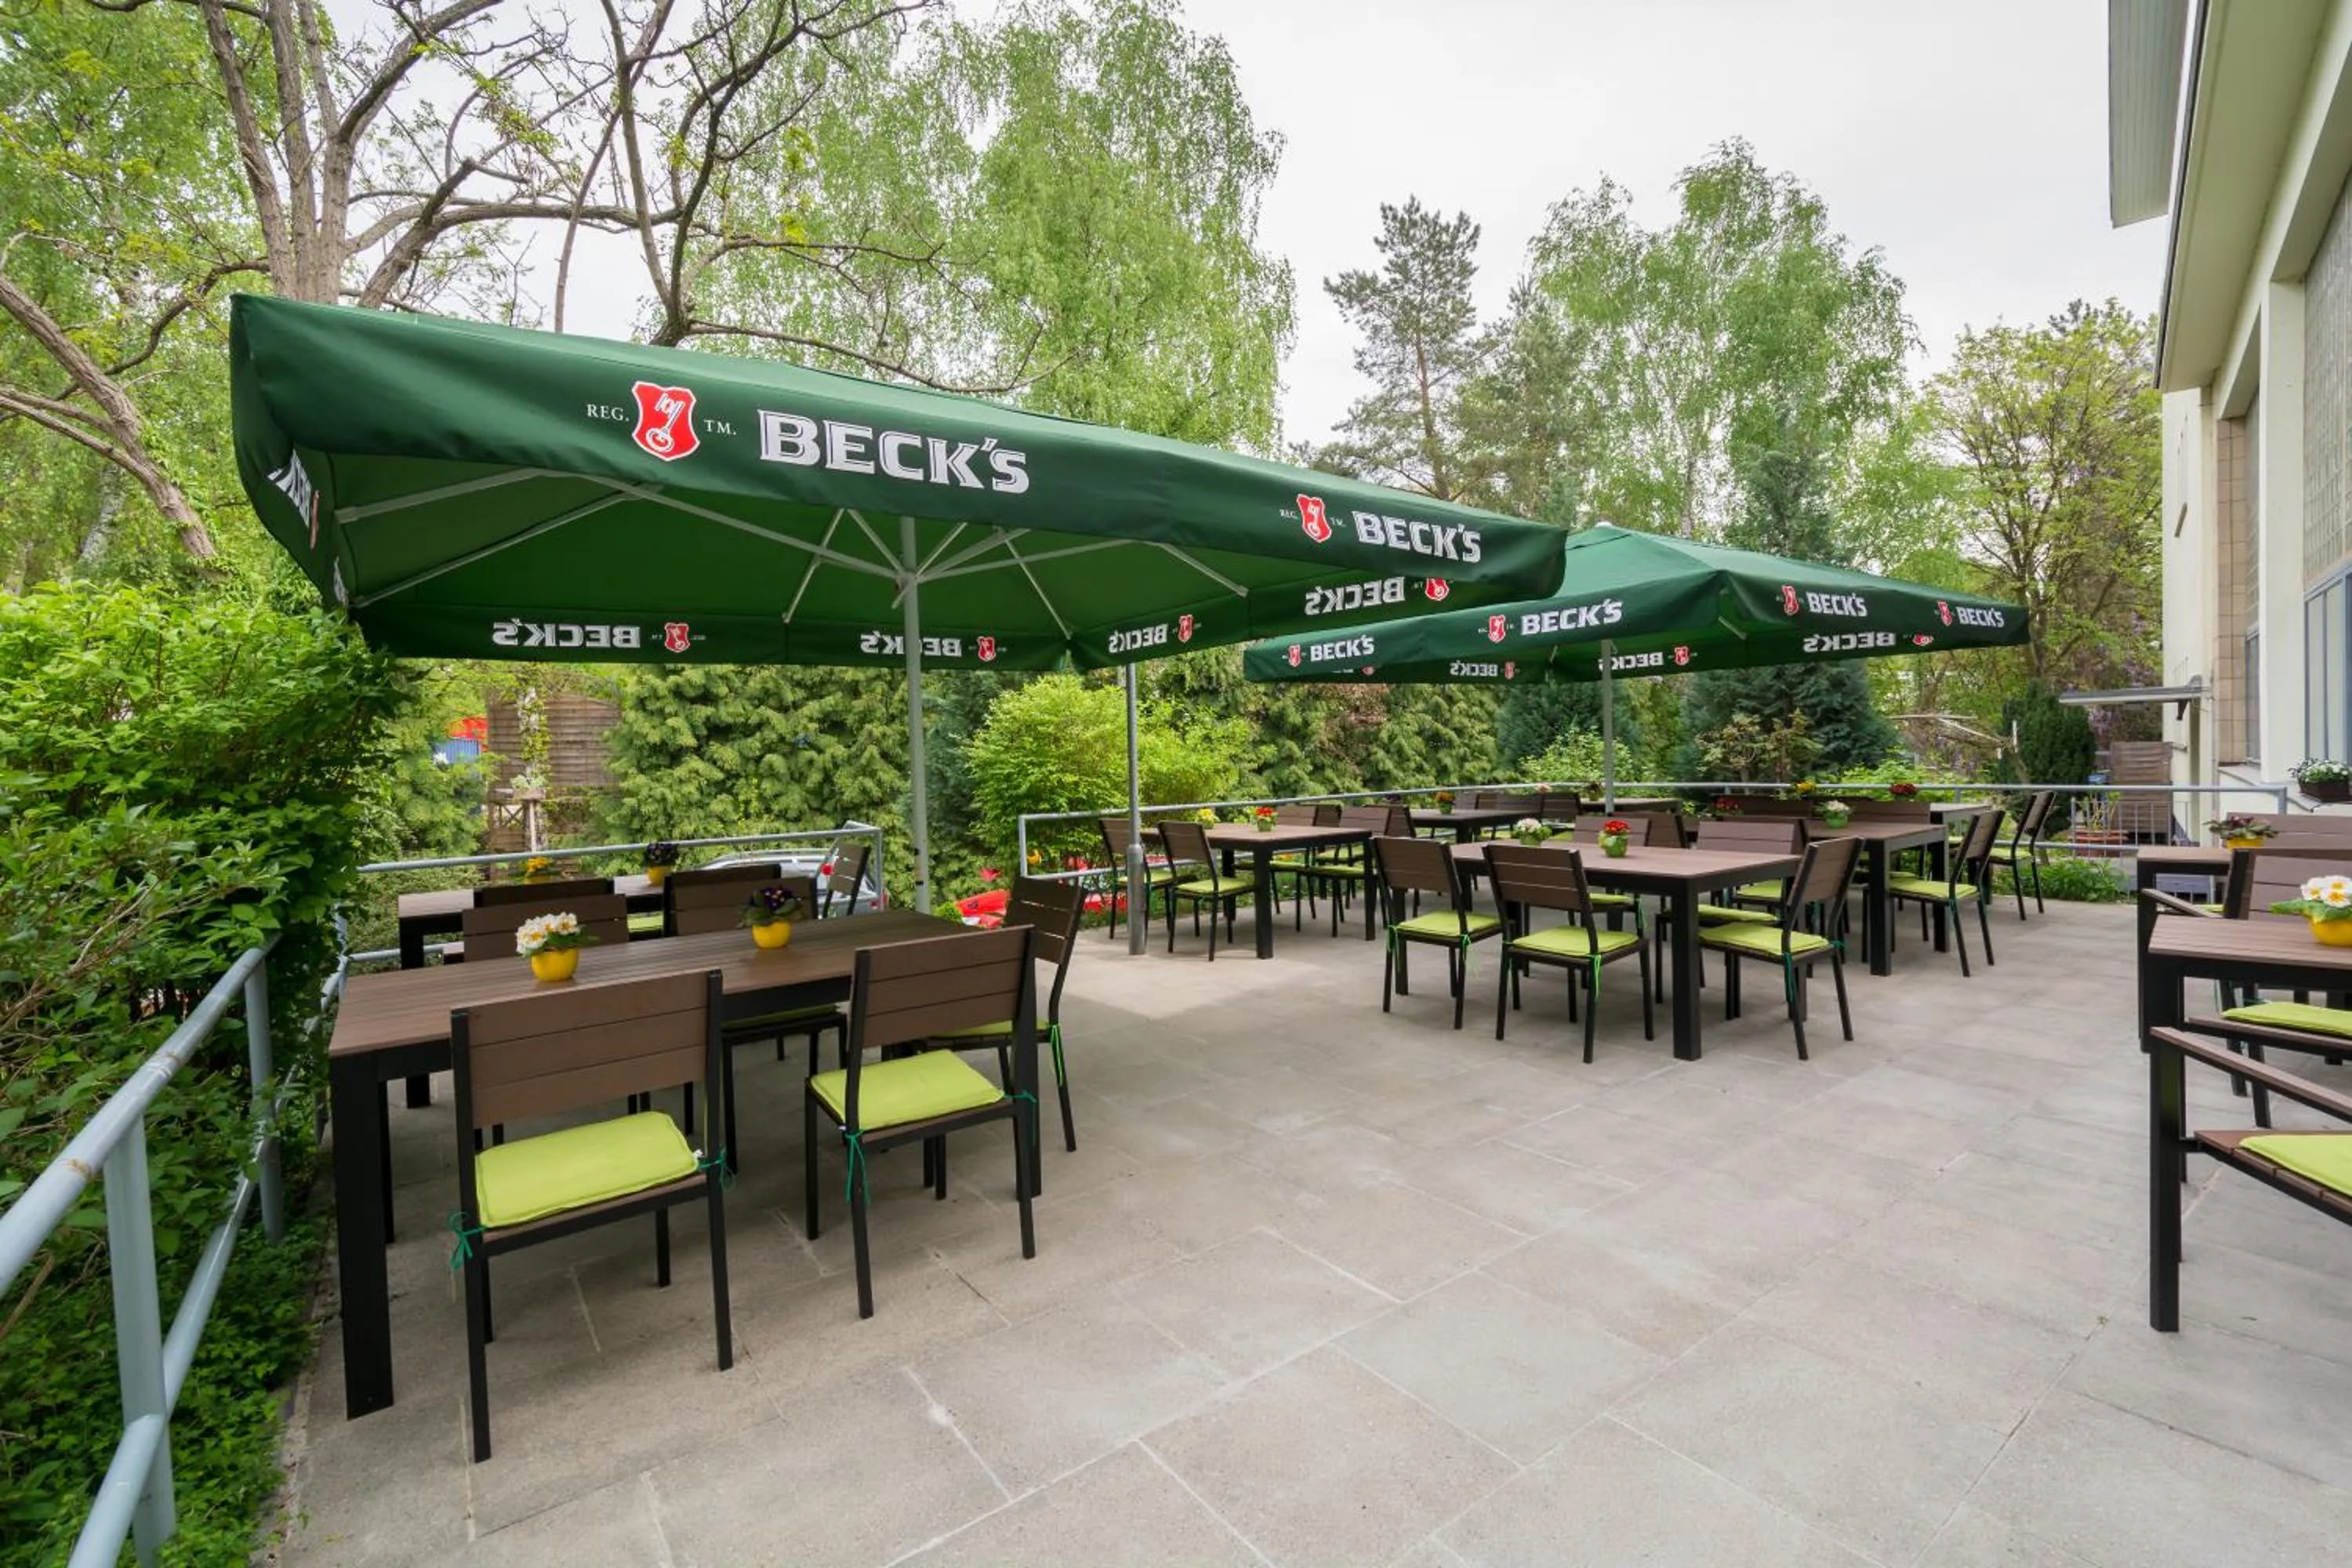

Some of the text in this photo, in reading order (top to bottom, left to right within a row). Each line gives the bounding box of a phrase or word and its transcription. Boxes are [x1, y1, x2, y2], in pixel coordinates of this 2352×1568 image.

[586, 404, 737, 435] REG. TM.
[757, 408, 1029, 494] BECK'S
[1352, 510, 1481, 563] BECK'S
[1520, 598, 1623, 636] BECK'S
[1806, 591, 1868, 617] BECK'S
[1955, 606, 2005, 628] BECK'S
[1309, 634, 1374, 662] BECK'S
